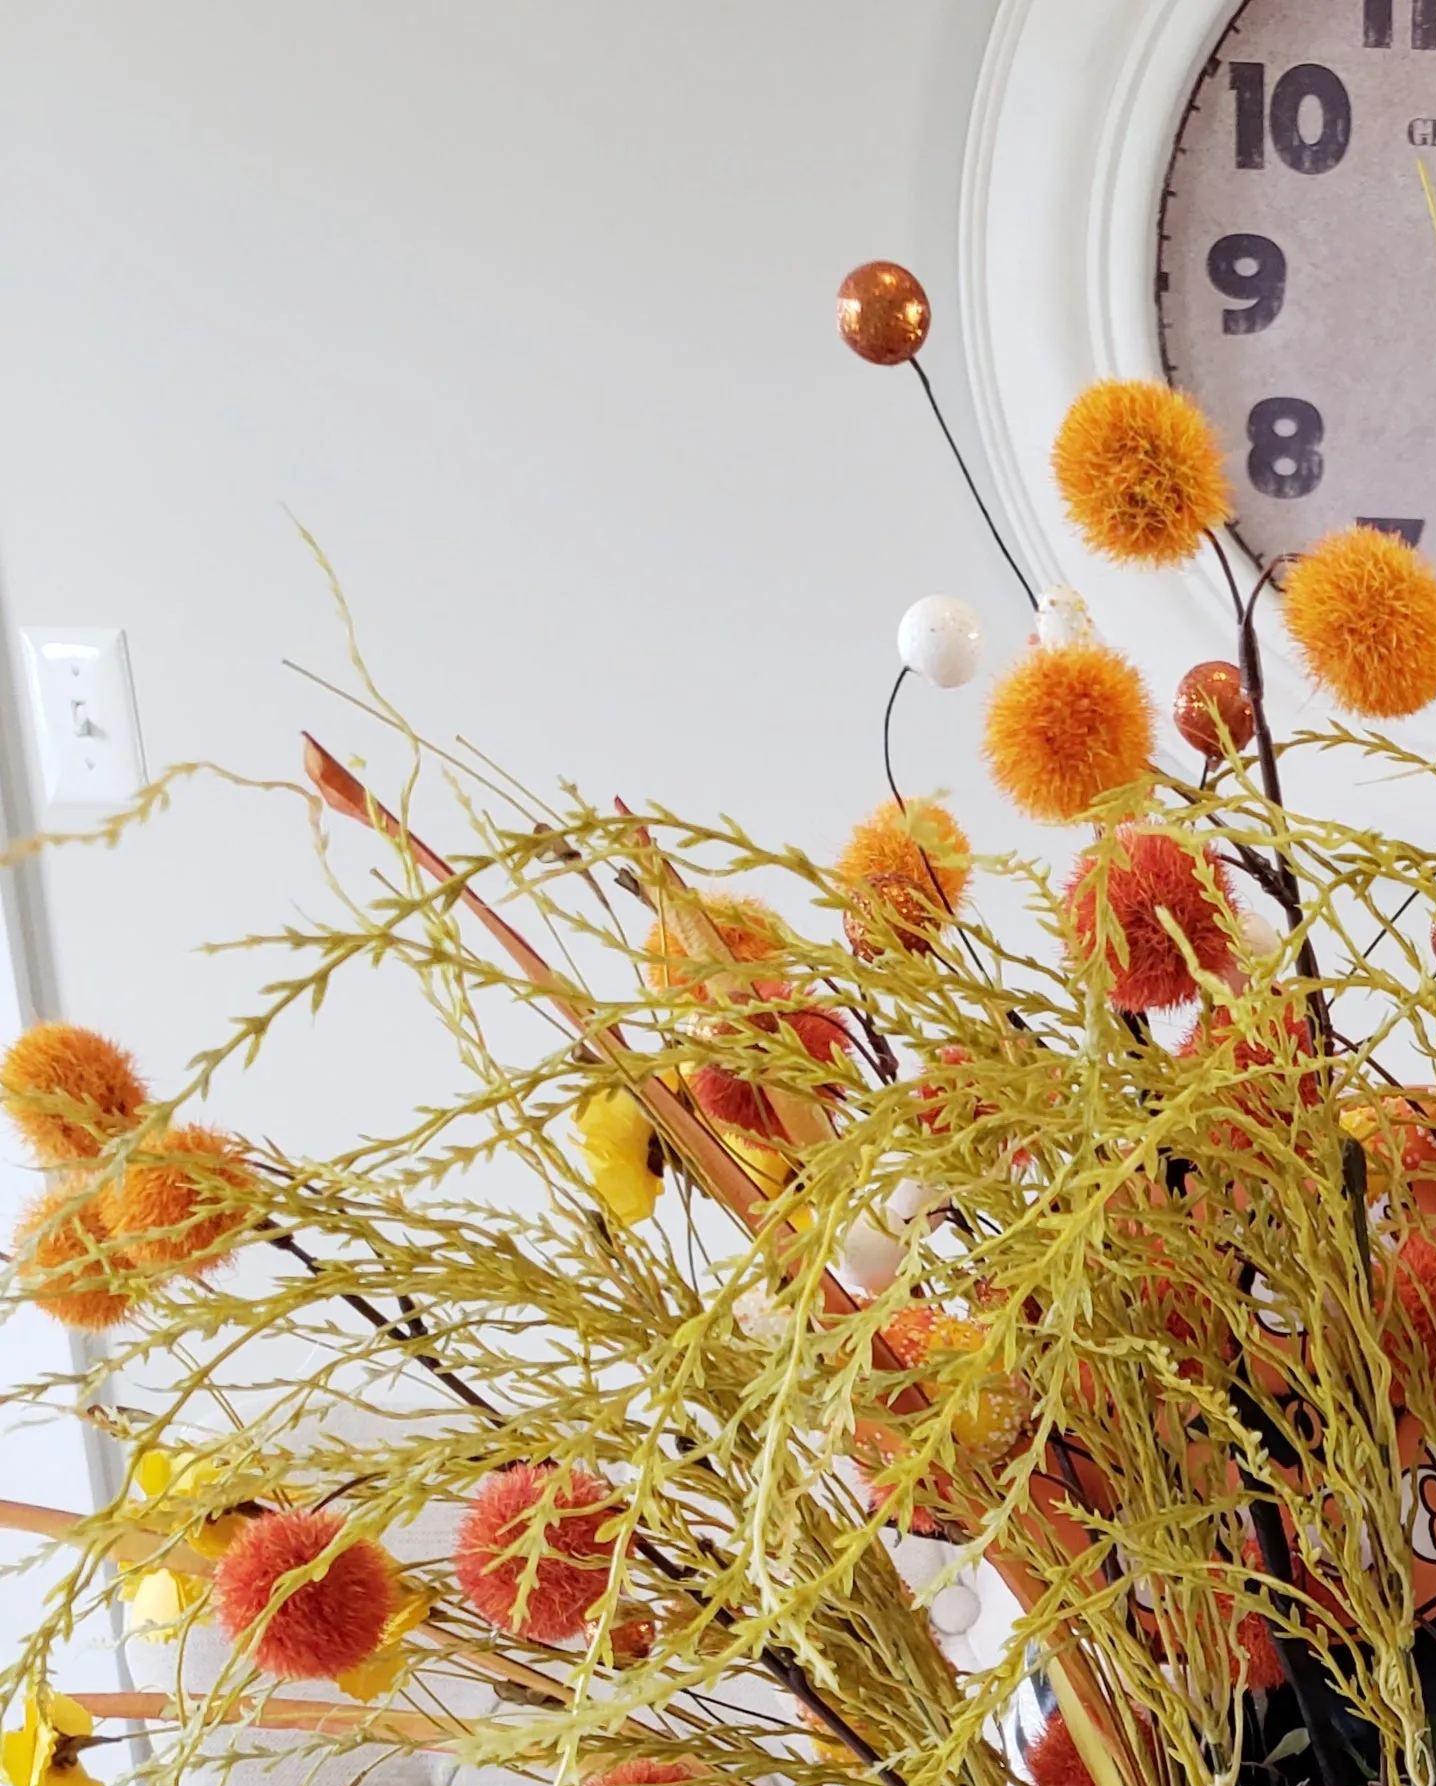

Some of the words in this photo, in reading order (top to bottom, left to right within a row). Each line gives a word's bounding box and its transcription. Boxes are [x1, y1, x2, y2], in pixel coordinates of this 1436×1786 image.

[1229, 62, 1352, 174] 10
[1207, 233, 1287, 335] 9
[1247, 397, 1324, 498] 8
